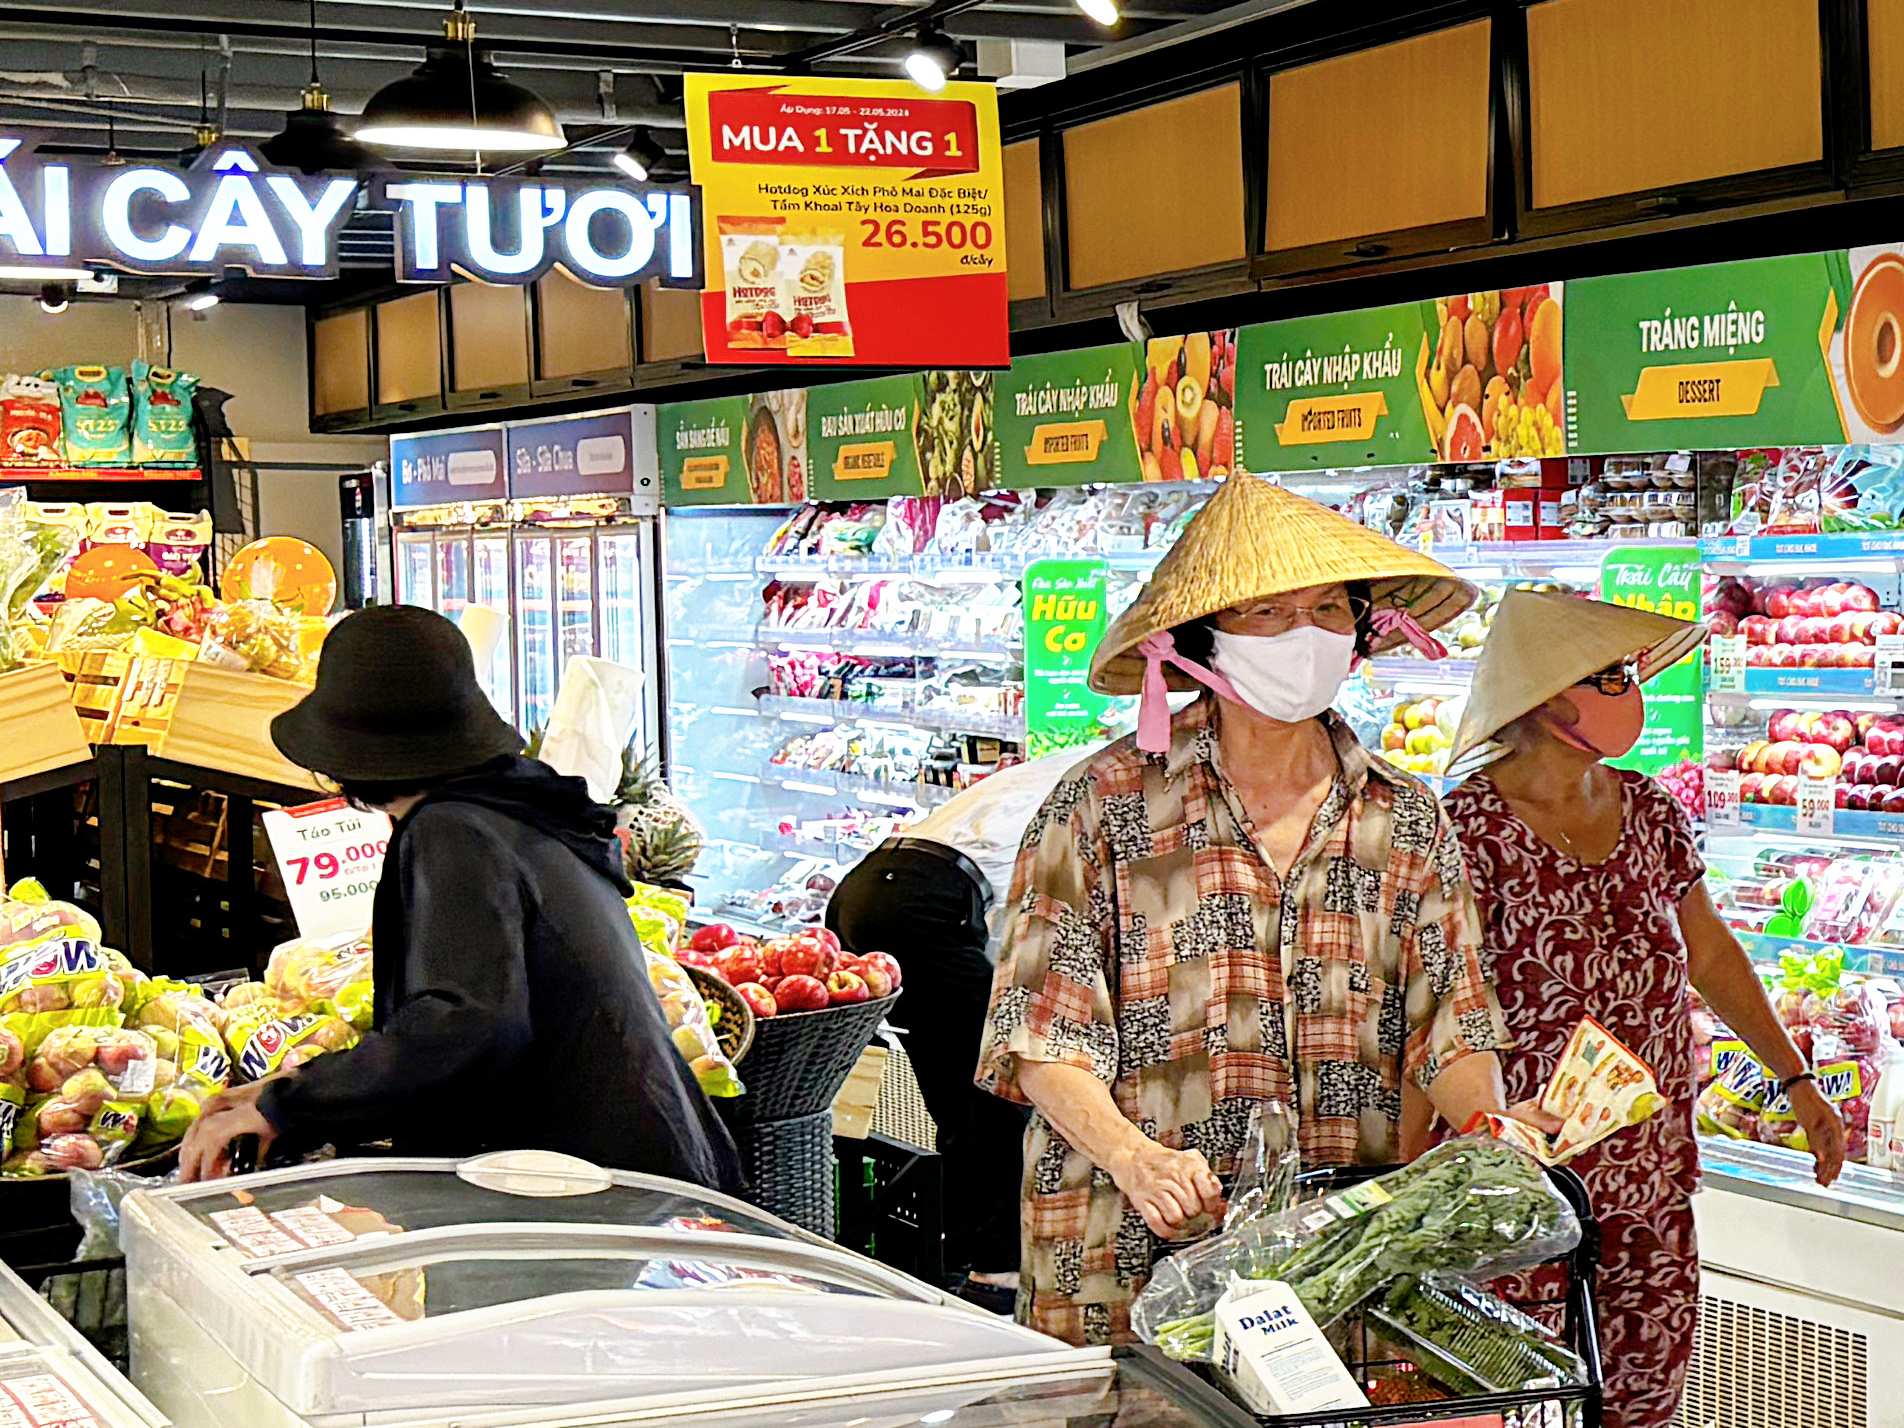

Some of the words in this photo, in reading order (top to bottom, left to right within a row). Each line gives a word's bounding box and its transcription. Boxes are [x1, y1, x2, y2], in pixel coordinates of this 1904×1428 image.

[722, 125, 804, 152] MUA
[814, 128, 833, 153] 1
[840, 122, 932, 161] TẶNG
[944, 132, 962, 156] 1
[758, 184, 808, 197] Hotdog
[813, 184, 837, 196] Xúc
[901, 186, 924, 198] Mai
[928, 187, 953, 201] Đặc
[103, 149, 358, 265] CÂY
[386, 184, 692, 279] TƯƠI
[846, 201, 869, 215] Tây
[874, 201, 899, 213] Hoa
[903, 203, 945, 214] Doanh
[950, 203, 991, 216] (125g)
[860, 219, 992, 249] 26.500
[1639, 306, 1699, 352] TRÁNG
[1703, 300, 1765, 355] MIỆNG
[1264, 358, 1294, 391] TRÁI
[1296, 352, 1321, 388] CÂY
[1322, 348, 1359, 391] NHẬP
[1361, 332, 1401, 381] KHẨU
[1678, 379, 1721, 405] DESSERT
[1607, 563, 1653, 586] Trái
[1657, 563, 1699, 591] Cây
[1032, 595, 1097, 621] Hữu
[1045, 626, 1086, 652] Cơ
[297, 826, 330, 841] Táo
[335, 818, 361, 833] Túi
[1238, 1305, 1294, 1334] Dalat
[1262, 1317, 1299, 1337] Milk
